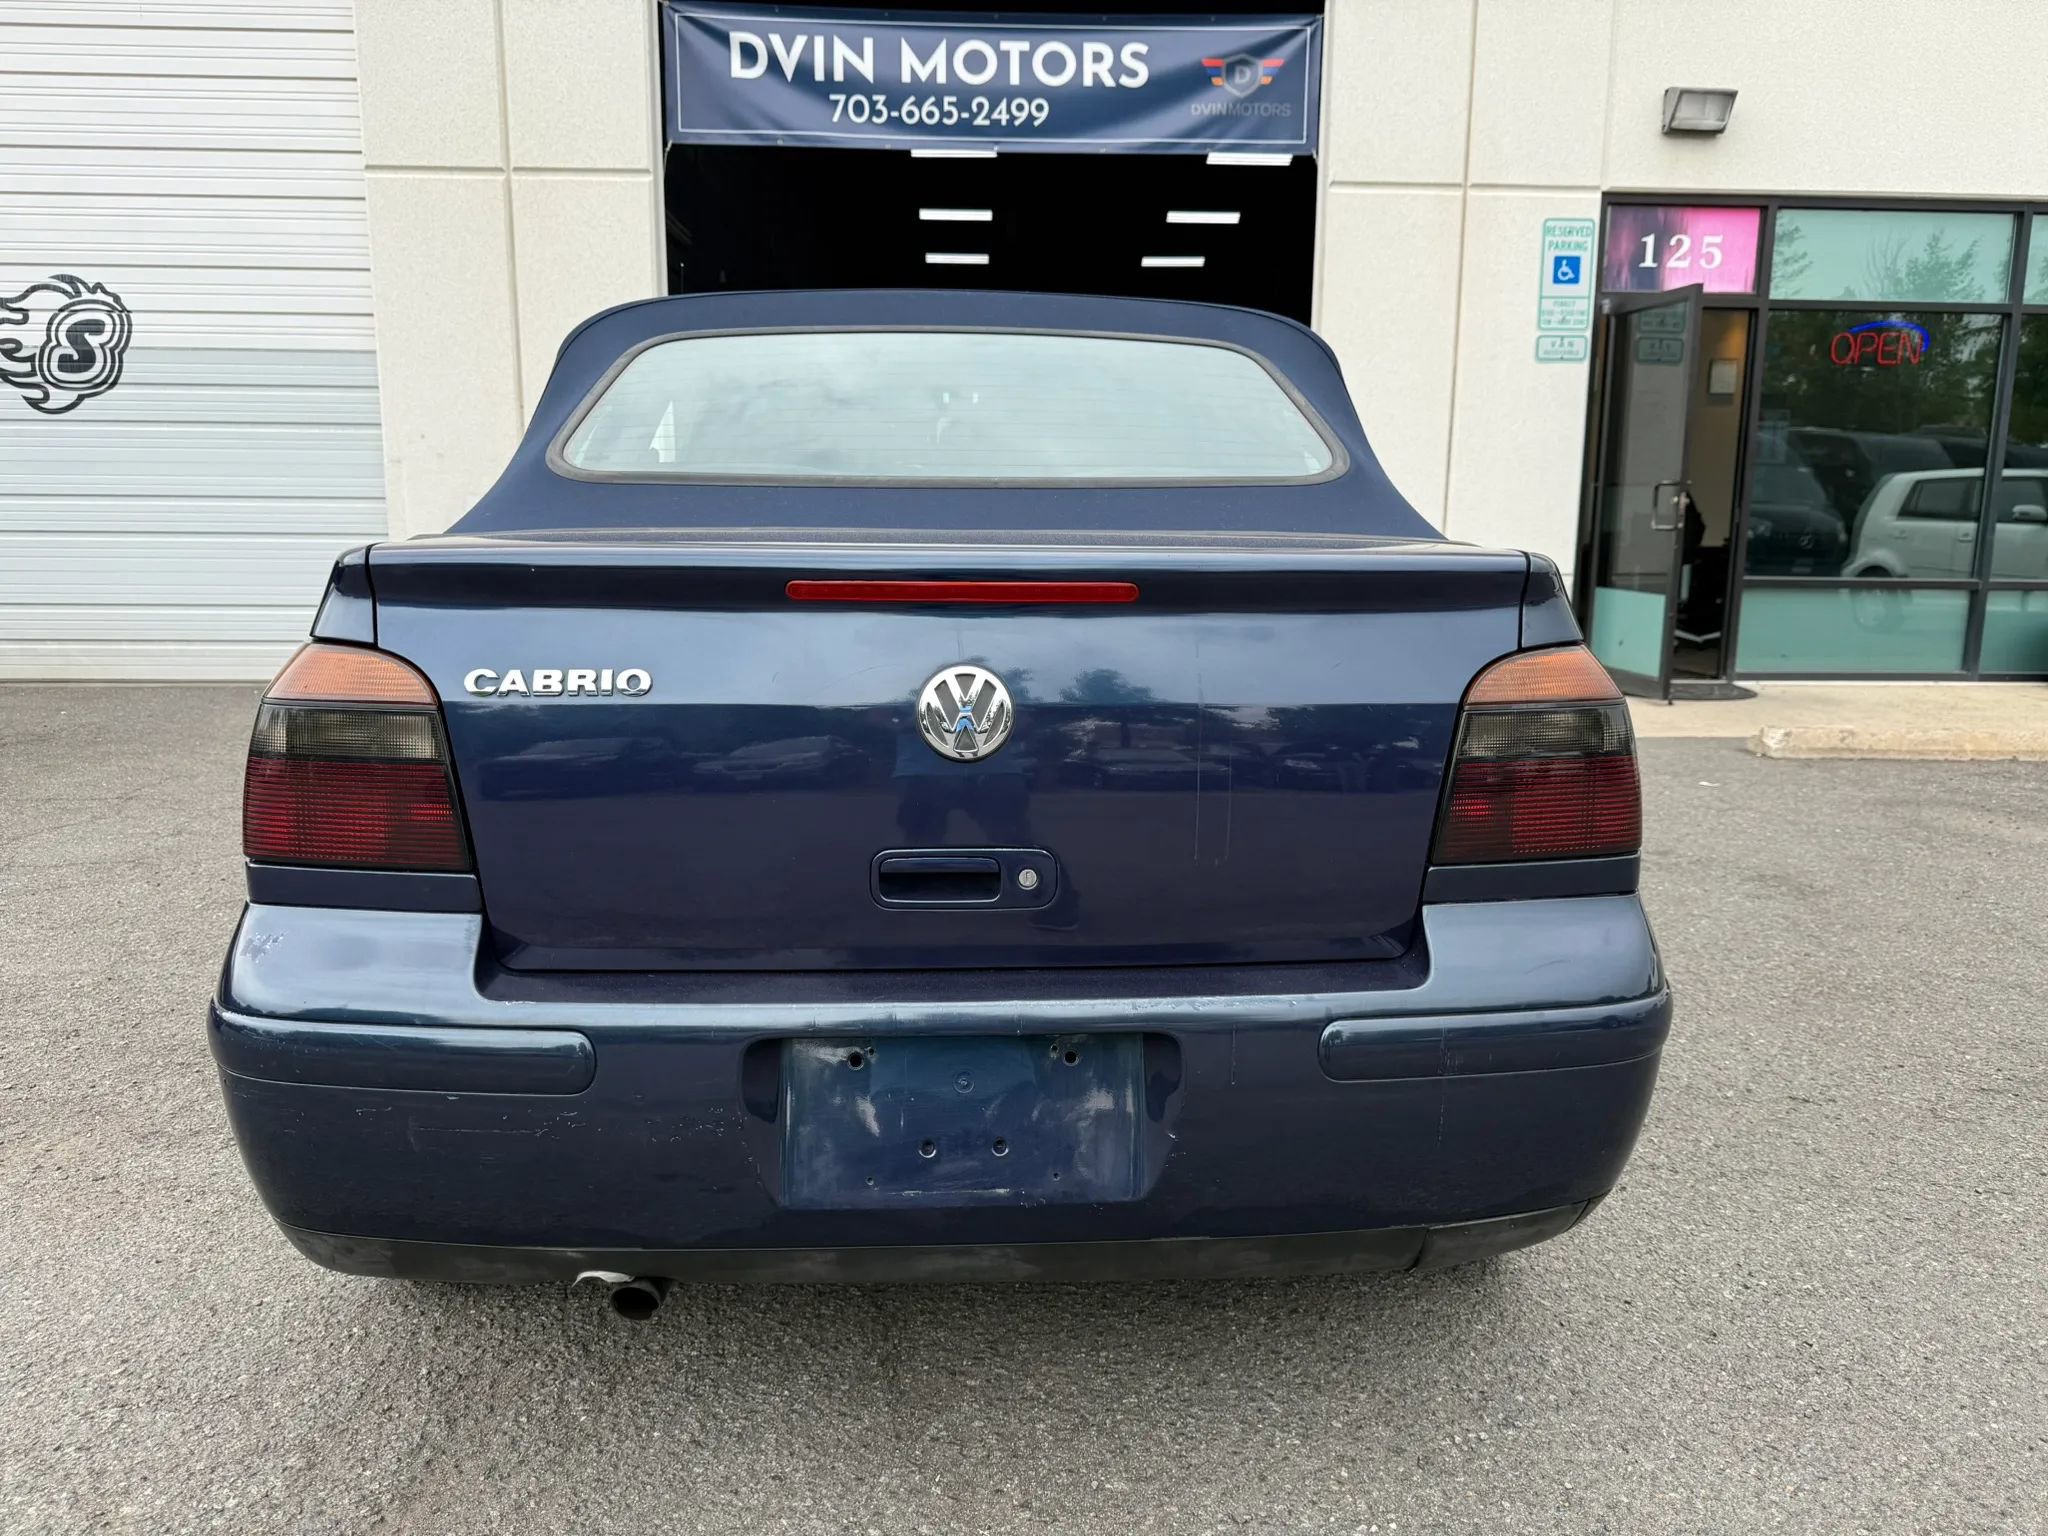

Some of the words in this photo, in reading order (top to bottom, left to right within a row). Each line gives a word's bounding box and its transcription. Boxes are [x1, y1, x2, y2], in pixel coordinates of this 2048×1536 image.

[728, 31, 876, 83] DVIN
[899, 37, 1150, 89] MOTORS
[1235, 67, 1250, 83] D
[829, 93, 1050, 128] 703-665-2499
[1545, 225, 1592, 237] RESERVED
[1548, 240, 1588, 251] PARKING
[1638, 233, 1723, 269] 125
[58, 319, 105, 373] S
[1831, 331, 1923, 365] OPEN
[463, 667, 653, 697] CABRIO
